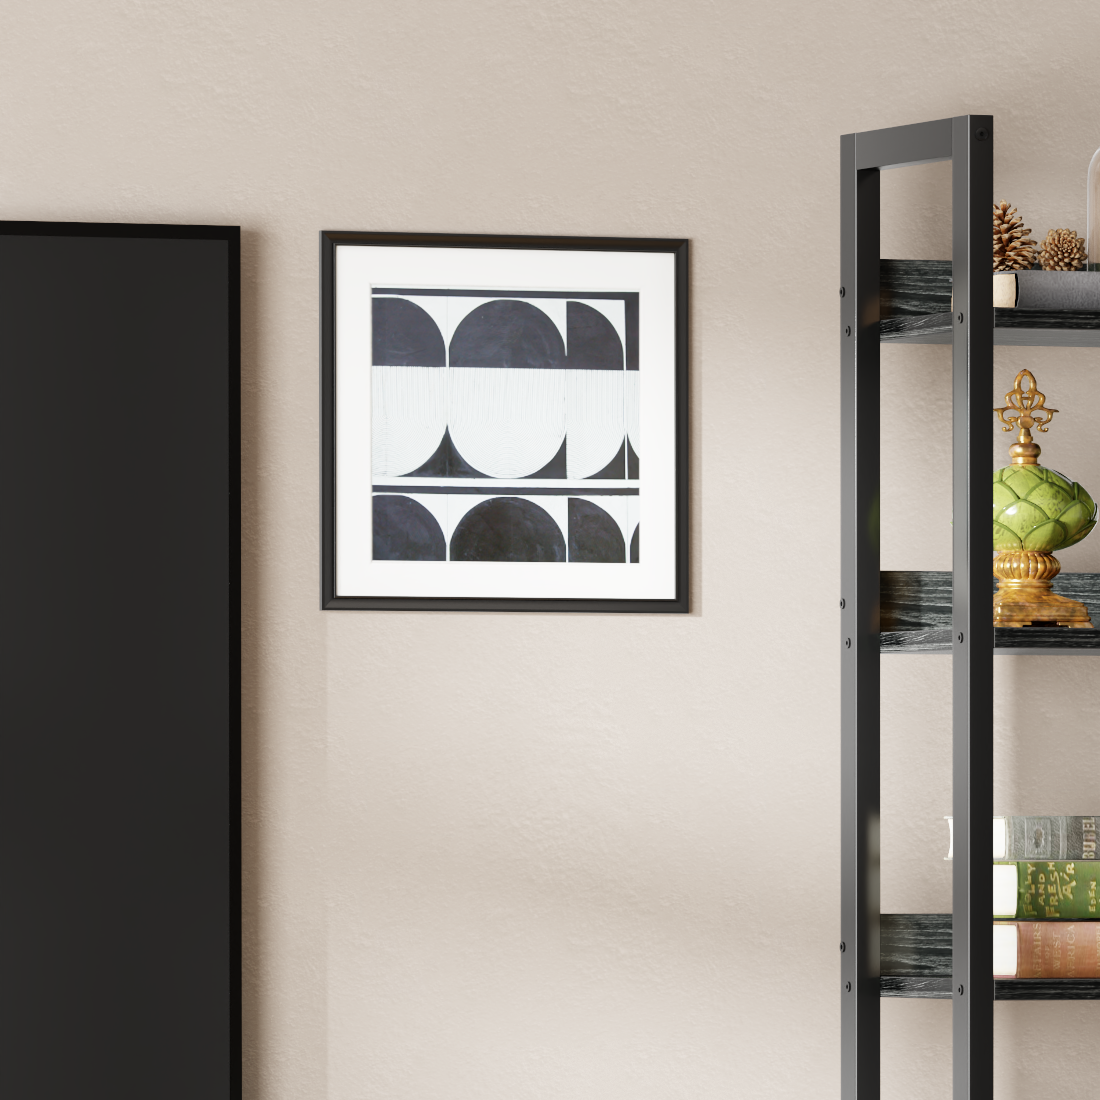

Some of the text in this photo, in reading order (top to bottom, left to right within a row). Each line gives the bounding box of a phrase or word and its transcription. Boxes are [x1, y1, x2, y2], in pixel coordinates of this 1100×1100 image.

[1023, 864, 1037, 916] FOLLY
[1038, 873, 1046, 906] AND
[1045, 862, 1063, 918] FRESH
[1088, 881, 1097, 912] EDEN
[1033, 923, 1042, 978] AFFAIRS
[1053, 931, 1062, 971] WEST
[1066, 924, 1075, 978] AFRICA
